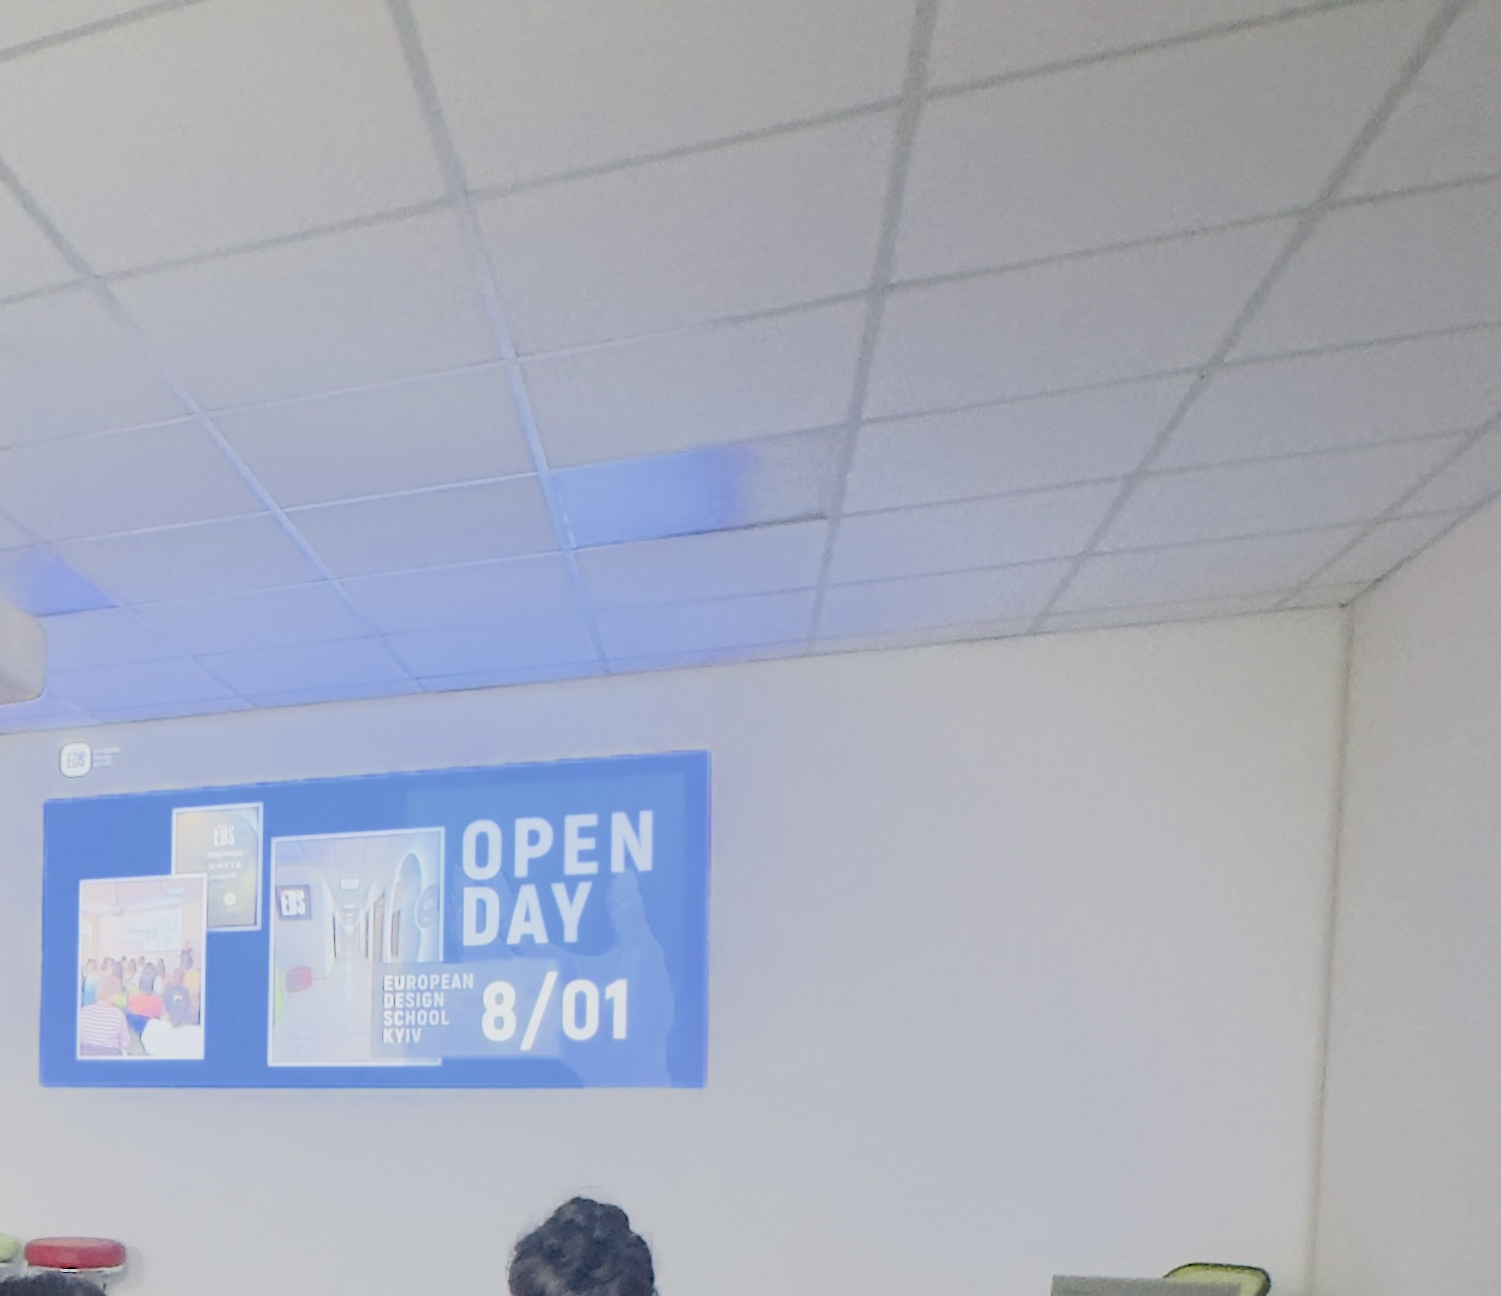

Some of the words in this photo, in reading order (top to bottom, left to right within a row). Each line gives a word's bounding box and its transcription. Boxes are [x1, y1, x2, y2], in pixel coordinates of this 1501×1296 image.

[213, 823, 235, 846] EDS
[462, 809, 654, 881] OPEN
[280, 889, 307, 916] EDS
[462, 881, 593, 947] DAY
[384, 973, 474, 991] EUROPEAN
[384, 991, 445, 1009] DESIGN
[481, 970, 628, 1052] 8/01
[383, 1008, 450, 1026] SCHOOL
[383, 1027, 422, 1044] KYIV
